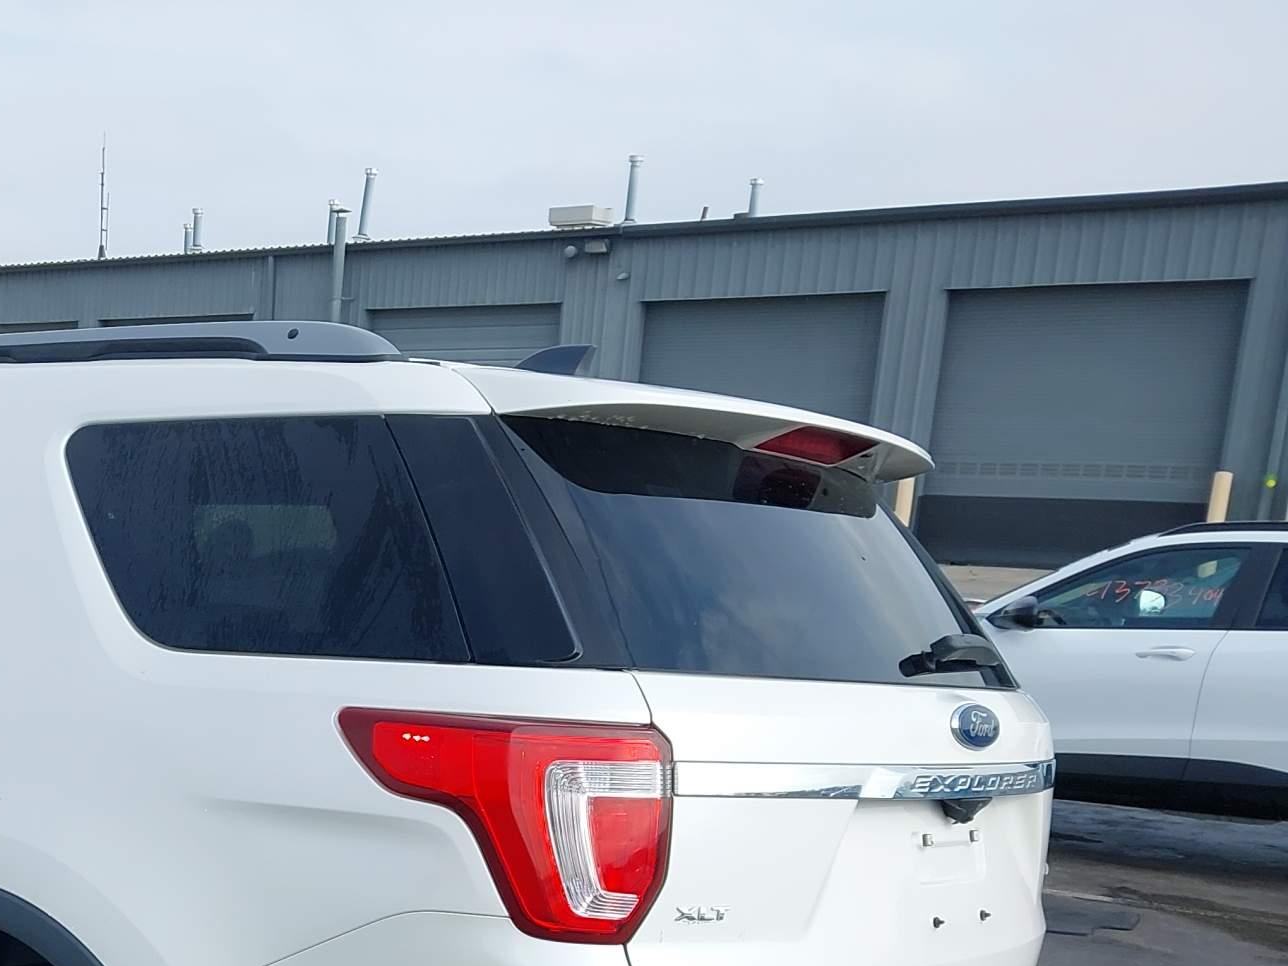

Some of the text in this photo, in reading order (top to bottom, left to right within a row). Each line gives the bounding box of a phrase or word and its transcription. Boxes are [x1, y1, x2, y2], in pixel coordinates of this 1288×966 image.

[969, 710, 995, 737] Ford
[911, 773, 1038, 793] EXPLORER
[673, 905, 731, 922] XLT
